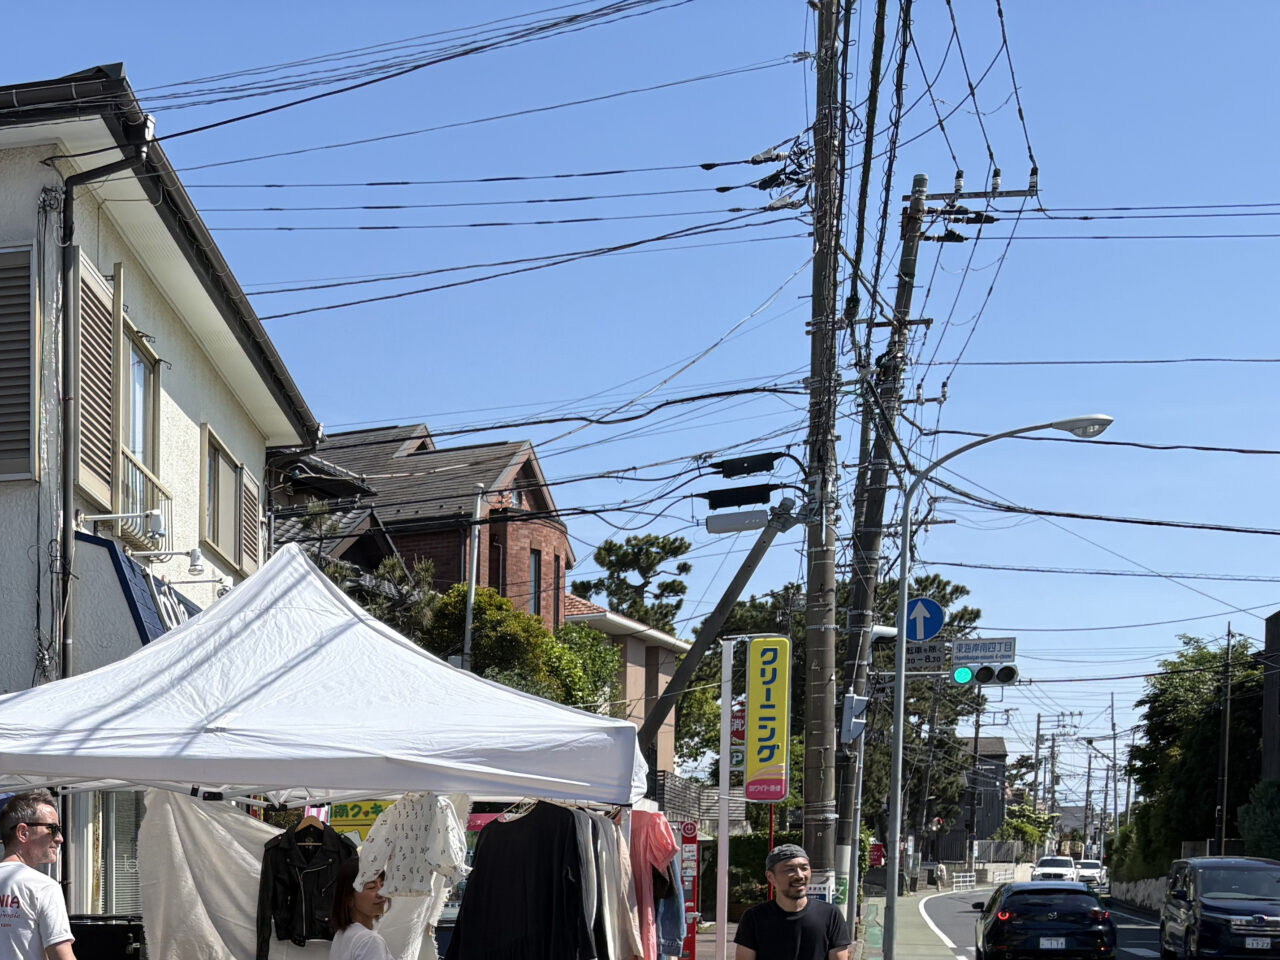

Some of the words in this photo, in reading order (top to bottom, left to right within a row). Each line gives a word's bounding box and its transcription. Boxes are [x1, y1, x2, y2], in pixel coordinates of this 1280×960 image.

[757, 647, 781, 763] クリーニング
